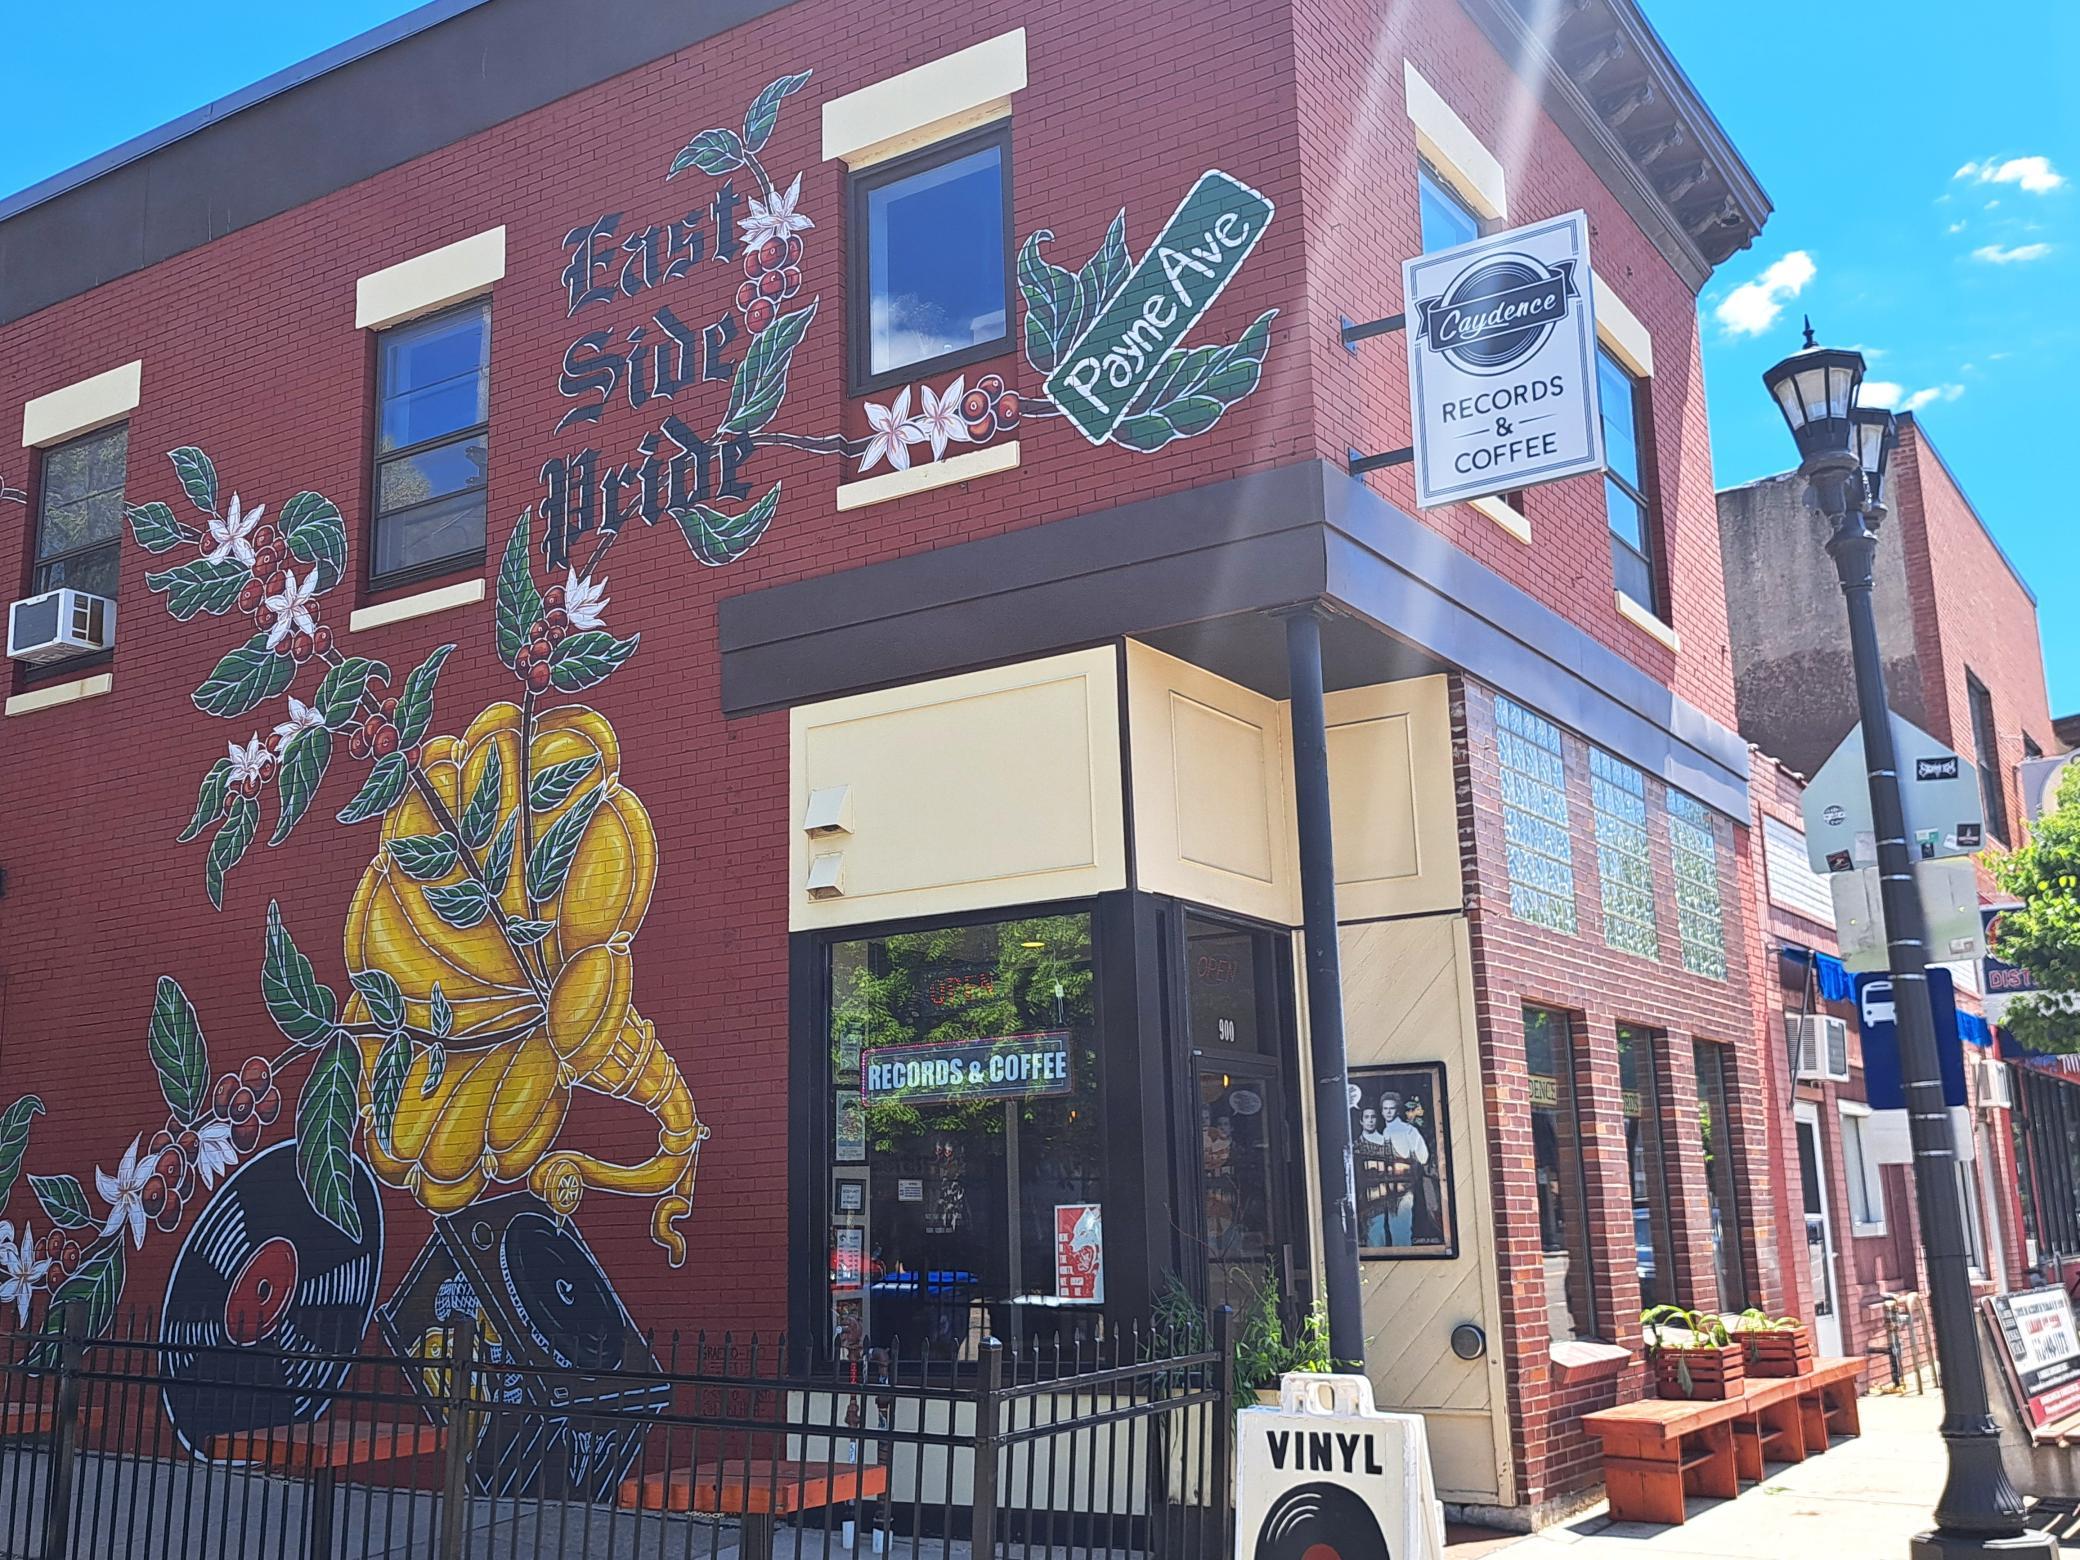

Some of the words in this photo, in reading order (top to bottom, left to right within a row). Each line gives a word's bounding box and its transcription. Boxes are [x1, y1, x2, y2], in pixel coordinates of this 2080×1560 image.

[561, 178, 742, 318] East
[1064, 294, 1178, 415] Payne
[1158, 212, 1250, 308] Ave
[1439, 293, 1556, 341] Caydence
[554, 305, 740, 436] Side
[1442, 375, 1564, 423] RECORDS
[1495, 416, 1513, 437] &
[1454, 432, 1558, 474] COFFEE
[539, 414, 756, 574] Pride
[1988, 966, 2039, 989] DIST
[1218, 1018, 1235, 1042] 900
[868, 1057, 963, 1091] RECORDS
[968, 1060, 984, 1084] &
[989, 1051, 1067, 1083] COFFEE
[1266, 1430, 1383, 1475] VINYL
